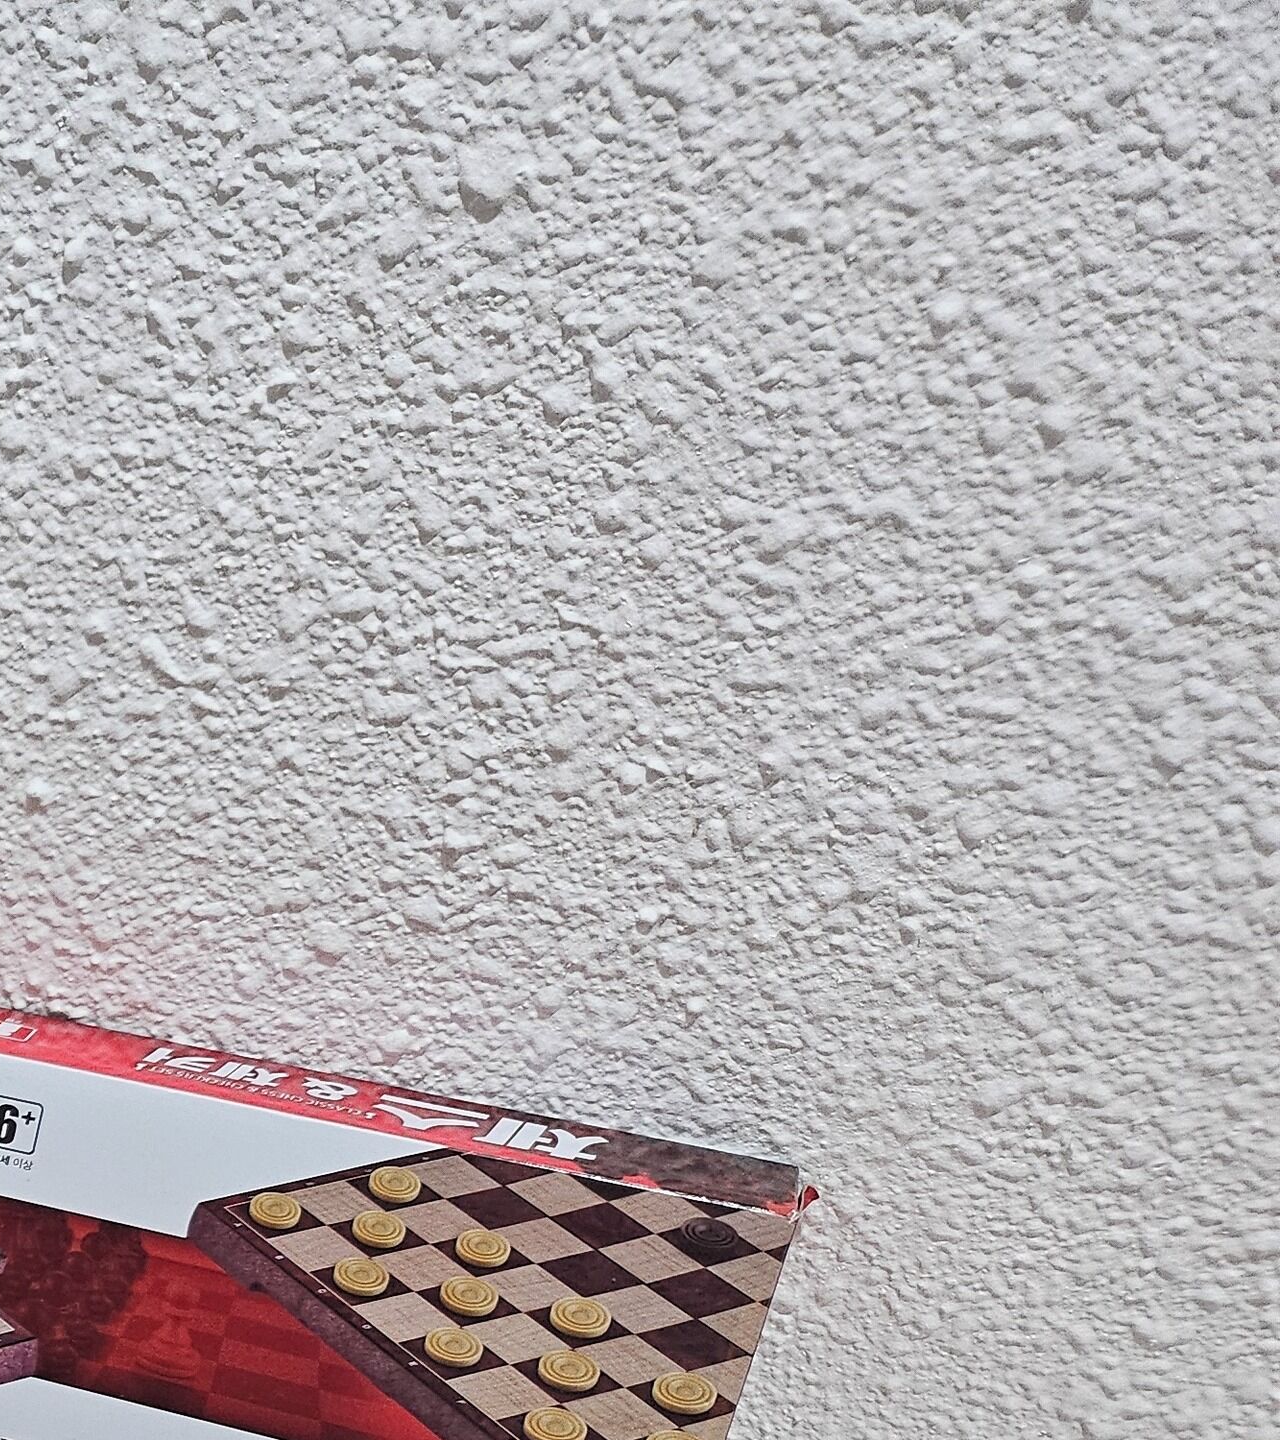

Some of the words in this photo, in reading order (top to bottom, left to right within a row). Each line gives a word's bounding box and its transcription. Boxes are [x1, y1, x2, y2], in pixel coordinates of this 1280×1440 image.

[143, 1047, 286, 1081] 체커
[304, 1079, 358, 1101] &
[377, 1094, 608, 1160] 체스
[12, 1156, 33, 1171] 이상
